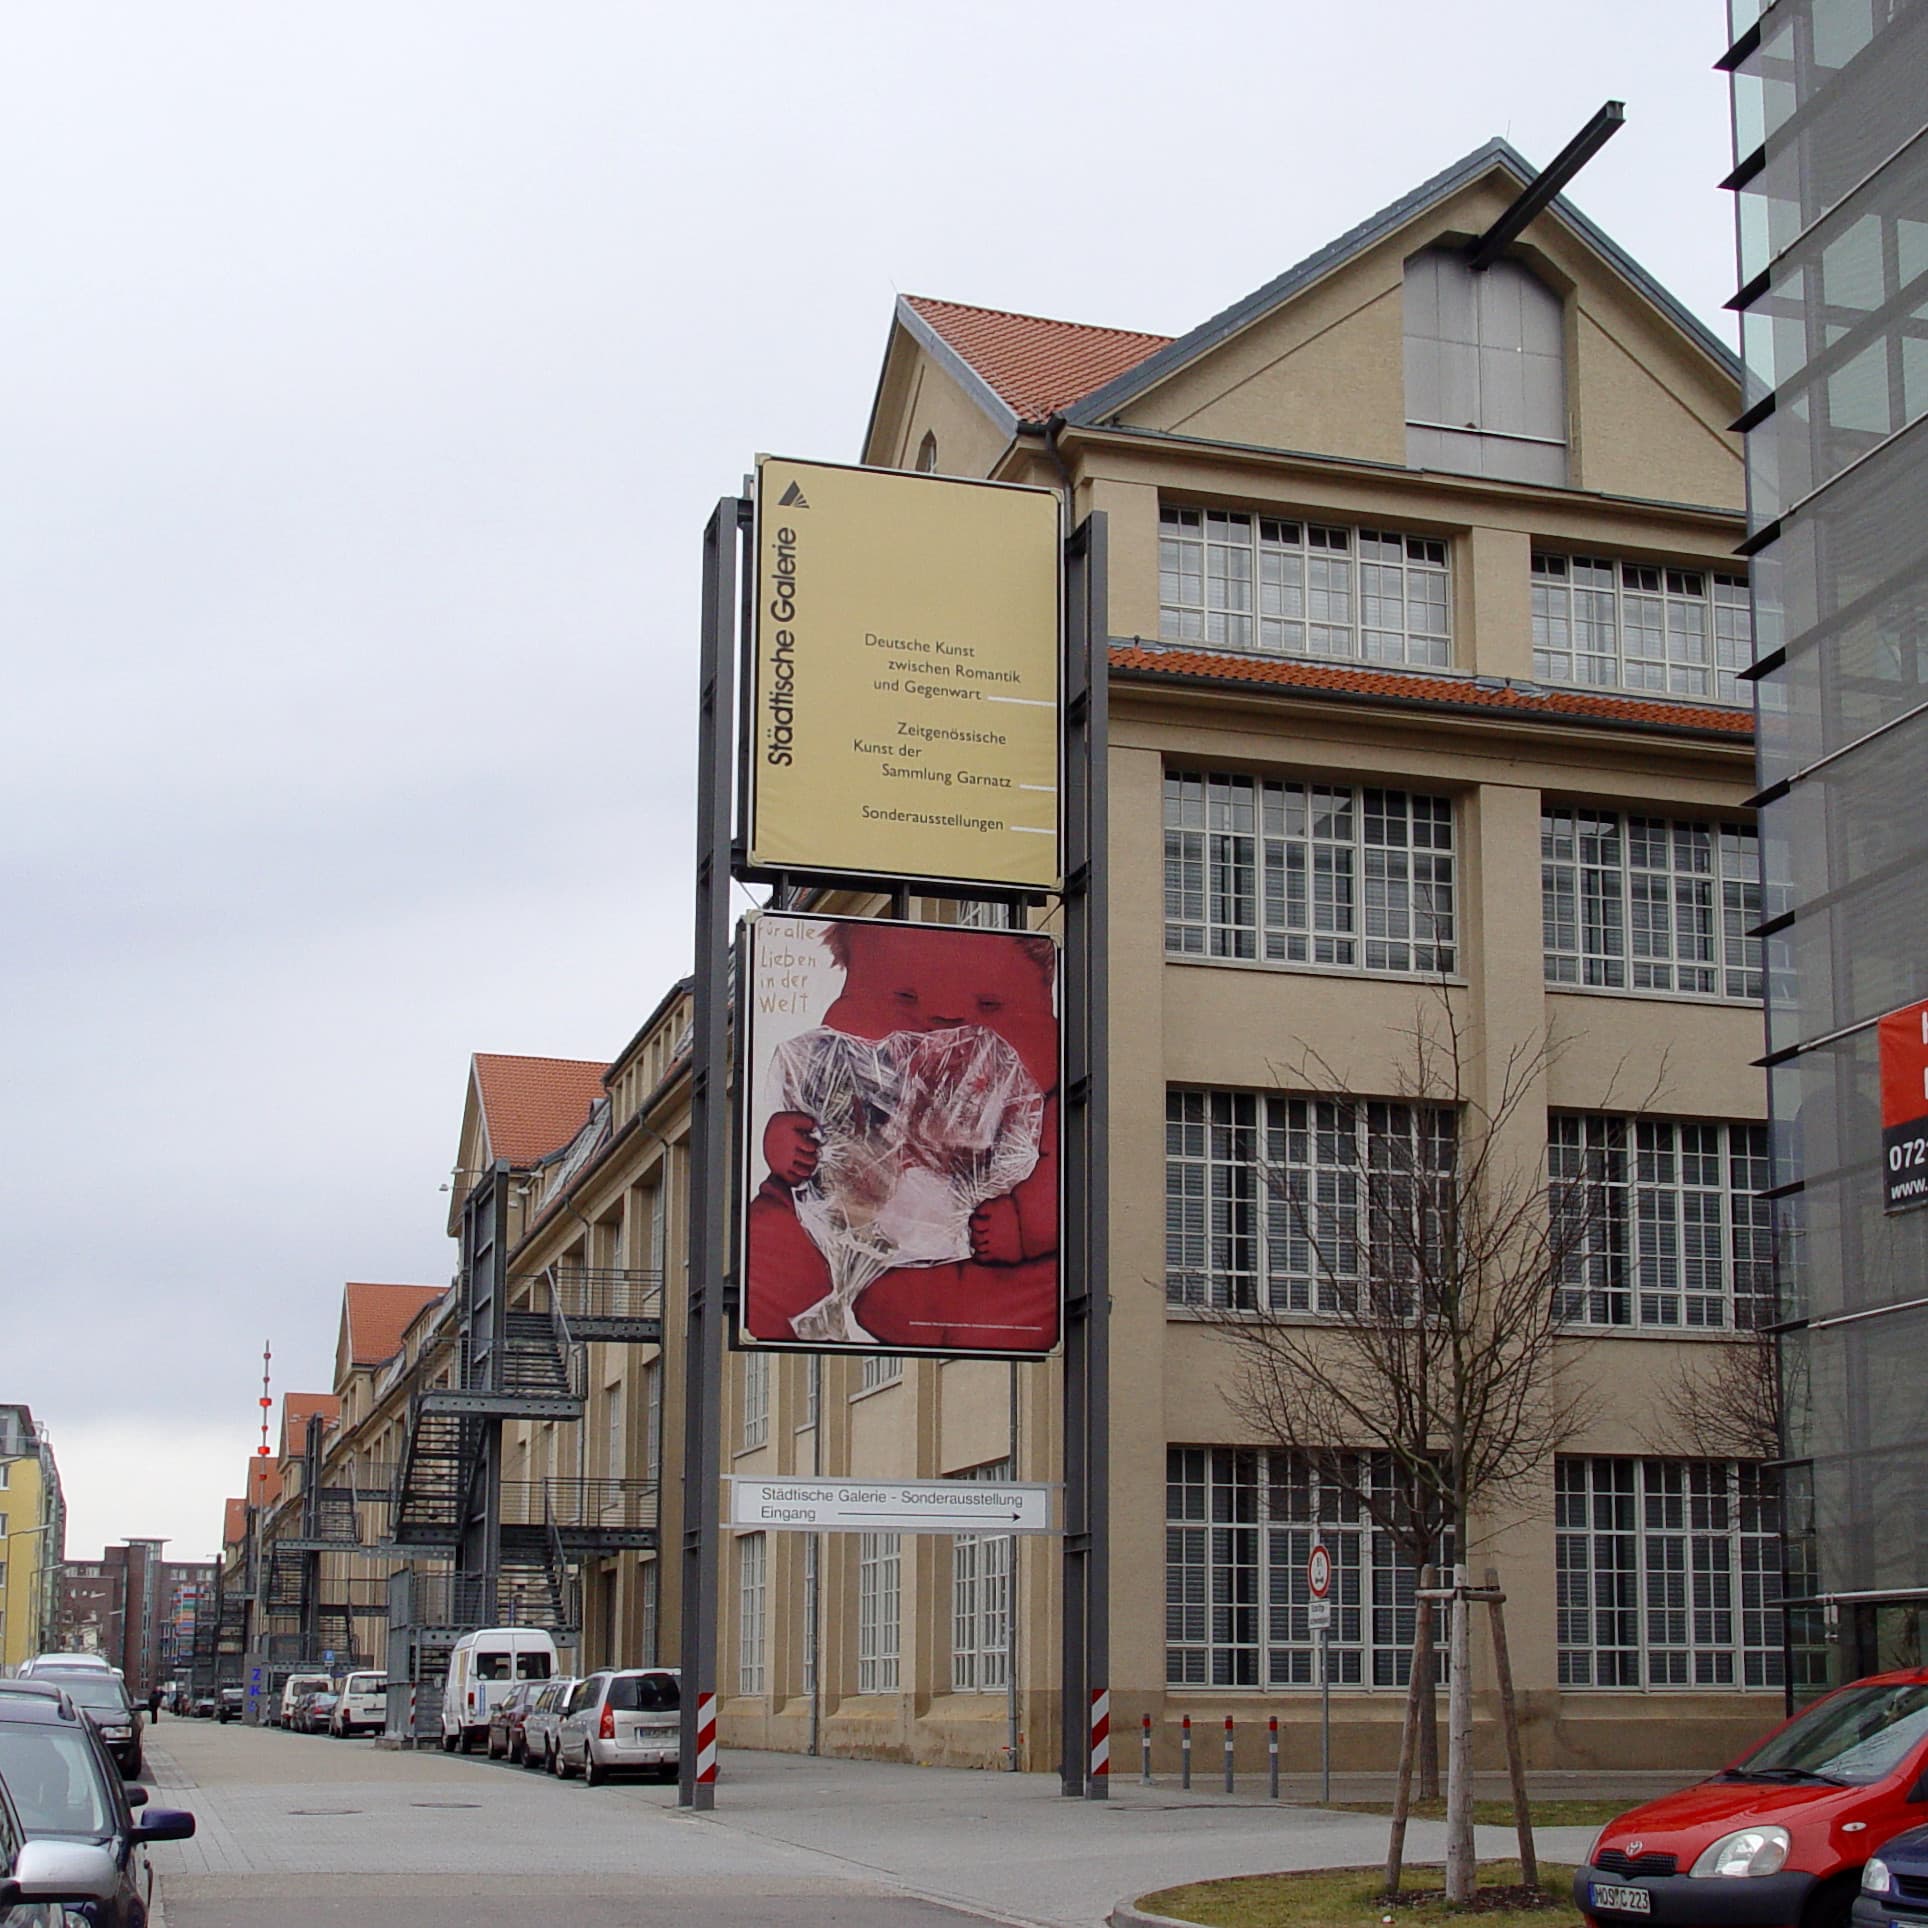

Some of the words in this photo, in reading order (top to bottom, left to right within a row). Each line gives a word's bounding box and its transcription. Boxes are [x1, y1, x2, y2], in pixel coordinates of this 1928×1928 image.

[770, 527, 796, 623] Galerie
[864, 633, 931, 653] Deutsche
[935, 640, 976, 658] Kunst
[888, 659, 951, 677] zwischen
[955, 664, 1022, 684] Romantik
[767, 629, 795, 767] Städtische
[873, 679, 900, 692] und
[904, 680, 982, 700] Gegenwart
[897, 721, 1007, 745] Zeitgenössische
[853, 738, 894, 756] Kunst
[898, 744, 923, 758] der
[881, 763, 953, 786] Sammlung
[956, 771, 1013, 788] Garnatz
[861, 805, 1005, 833] Sonderausstellungen
[784, 920, 816, 941] alle
[760, 945, 817, 969] Lieben
[760, 978, 775, 989] in
[781, 969, 808, 989] der
[760, 992, 809, 1015] Welt
[1889, 1138, 1928, 1171] 072
[761, 1487, 834, 1502] Städtische
[838, 1489, 887, 1504] Galerie
[901, 1490, 1023, 1508] Sonderausstellung
[760, 1506, 816, 1522] Eingang
